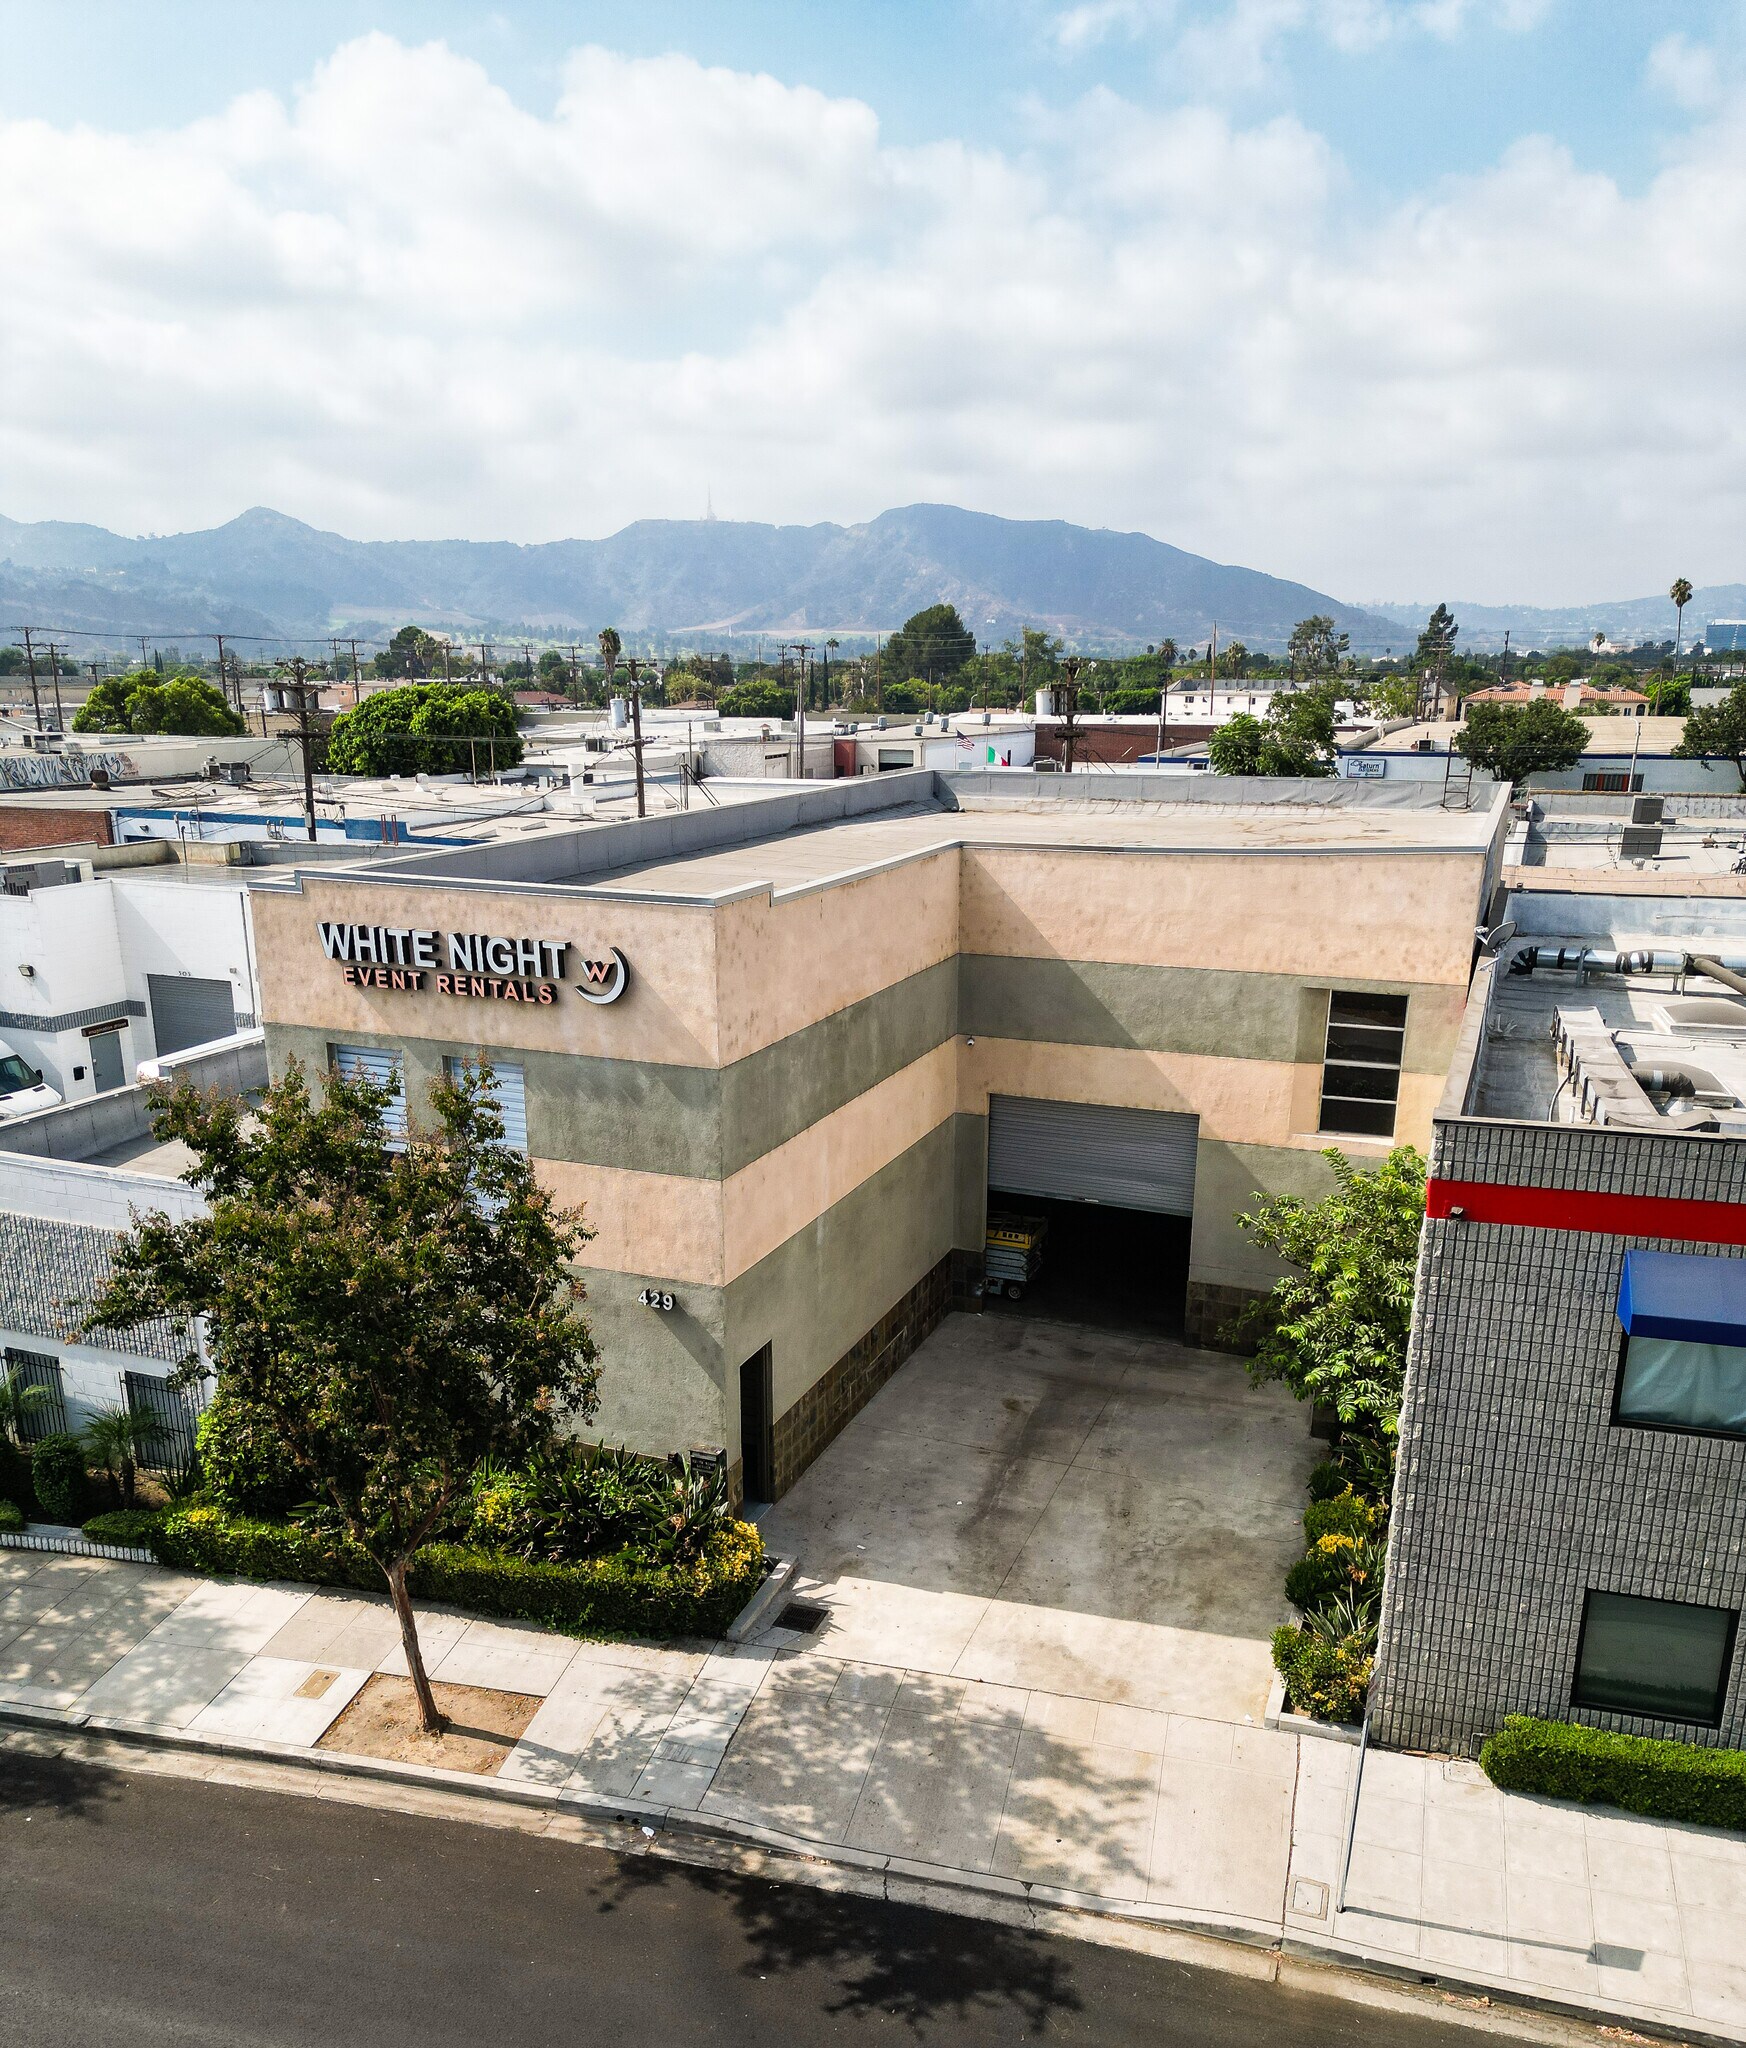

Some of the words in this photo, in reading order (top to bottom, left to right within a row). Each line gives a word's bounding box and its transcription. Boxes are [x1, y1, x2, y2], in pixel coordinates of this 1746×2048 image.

[316, 922, 438, 968] WHITE
[448, 932, 571, 979] NIGHT
[343, 966, 425, 992] EVENT
[436, 974, 557, 1005] RENTALS
[581, 959, 615, 984] W
[637, 1287, 676, 1311] 429
